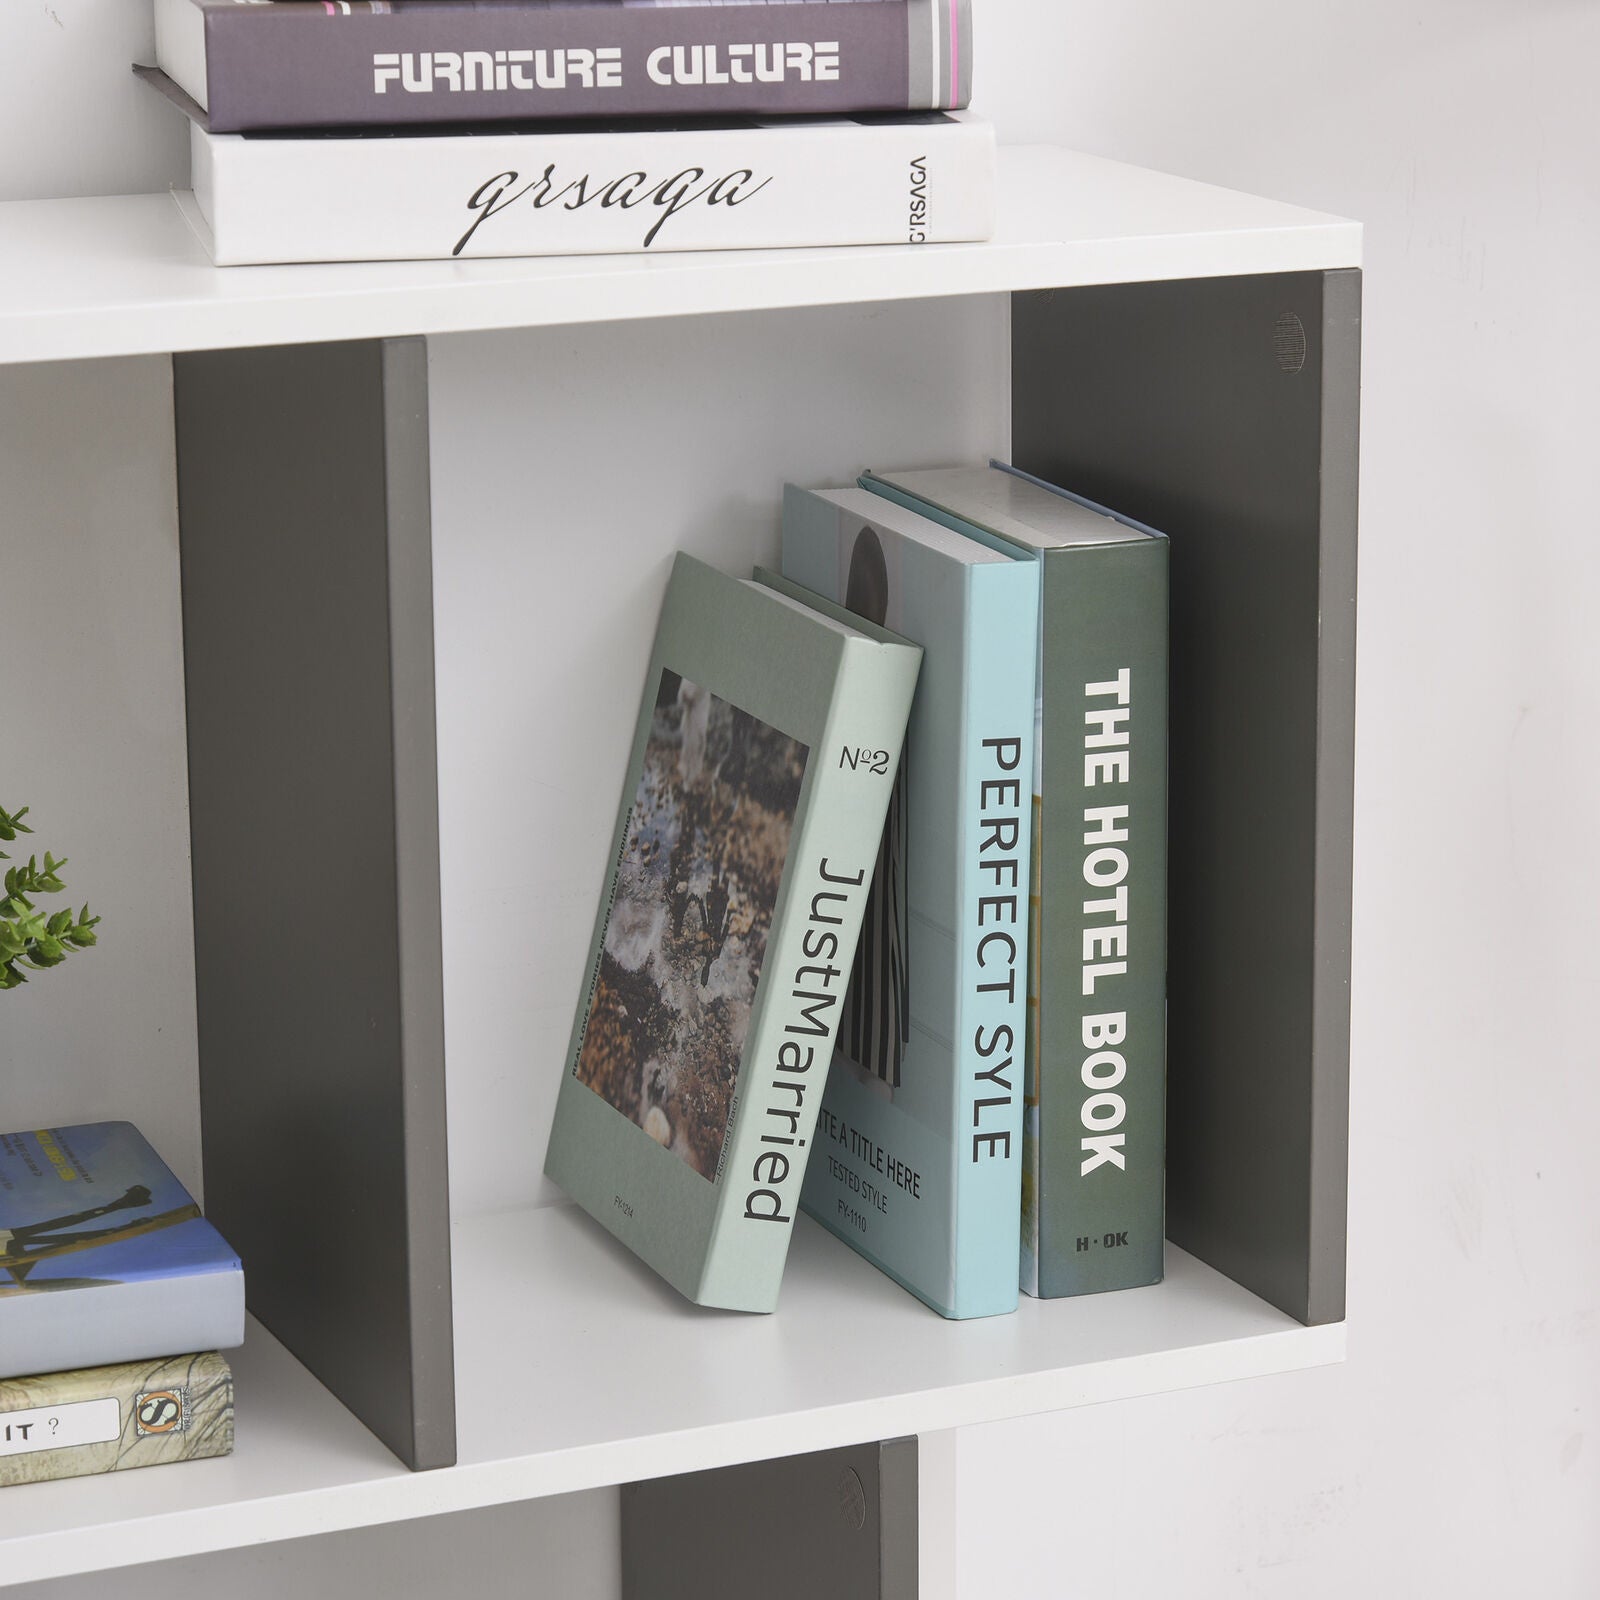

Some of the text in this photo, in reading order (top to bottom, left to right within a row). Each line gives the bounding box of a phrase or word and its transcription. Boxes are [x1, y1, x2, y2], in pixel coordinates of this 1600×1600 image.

[646, 41, 840, 85] CULTURE
[452, 163, 773, 256] grsaga
[579, 1009, 590, 1041] LOVE
[587, 952, 601, 1005] STORIES
[599, 907, 612, 950] NEVER
[609, 871, 620, 904] HAVE
[972, 737, 1022, 1163] PERFECT SYLE
[1080, 667, 1130, 1177] THE HOTEL BOOK
[743, 856, 866, 1223] JustMarried
[728, 1096, 739, 1128] Bach
[816, 1107, 921, 1200] ITE A TITLE HERE
[827, 1154, 888, 1215] TESTED STYLE
[837, 1198, 867, 1233] FY-1110
[5, 1423, 35, 1442] IT
